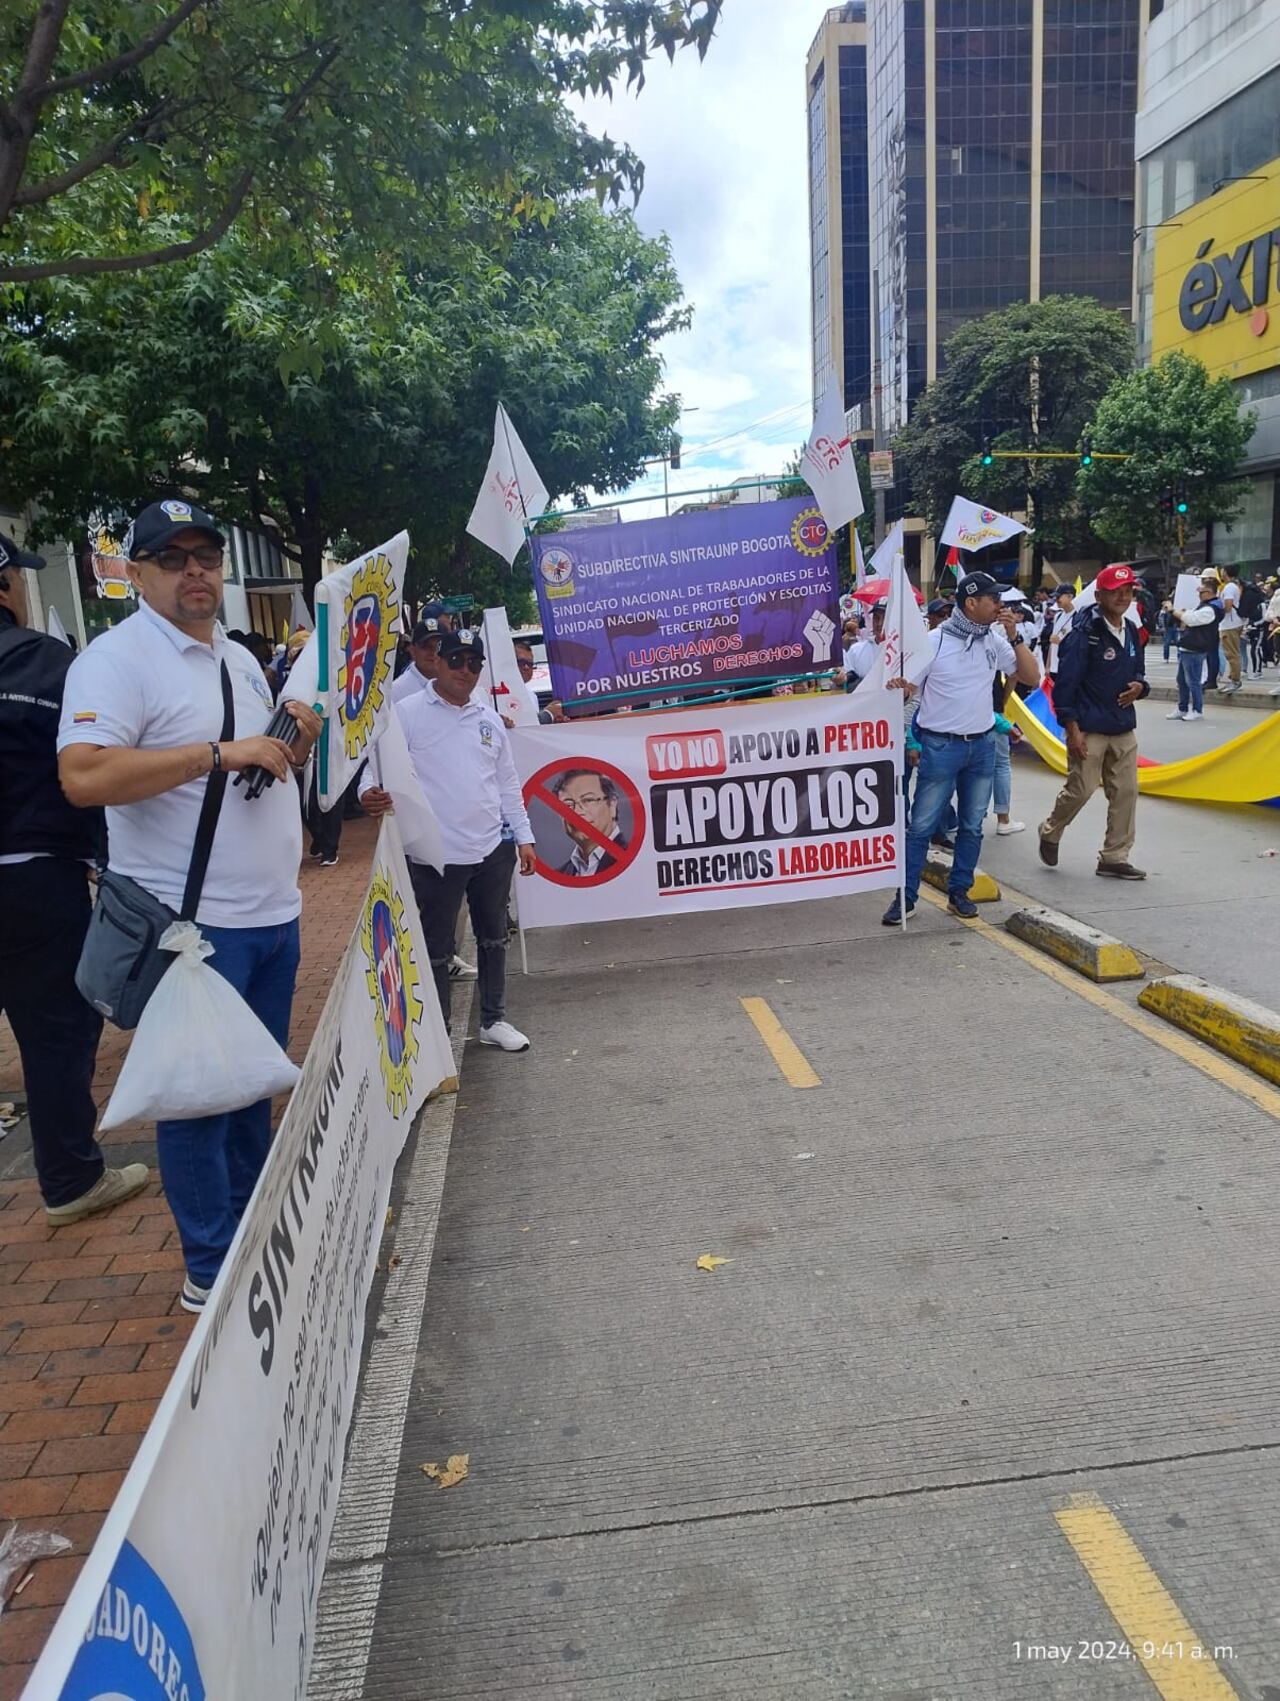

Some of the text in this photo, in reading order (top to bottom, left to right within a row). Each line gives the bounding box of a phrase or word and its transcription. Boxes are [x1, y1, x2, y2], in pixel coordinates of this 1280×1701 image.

[577, 535, 791, 579] SUBDIRECTIVA SINTRAUNP BOGOTA
[800, 524, 826, 539] CTC
[552, 566, 829, 618] SINDICATO NACIONAL DE TRABAJADORES DE LA
[554, 582, 832, 636] UNIDAD NACIONAL DE PROTECCIÓN Y ESCOLTAS
[658, 614, 739, 636] TERCERIZADO
[576, 644, 803, 695] POR NUESTROS DERECHOS
[629, 635, 743, 667] LUCHAMOS
[652, 720, 894, 771] YO NO APOYO A PETRO,
[665, 768, 878, 846] APOYO LOS
[657, 834, 895, 888] DERECHOS LABORALES
[281, 1382, 297, 1447] no
[292, 1315, 307, 1387] sea
